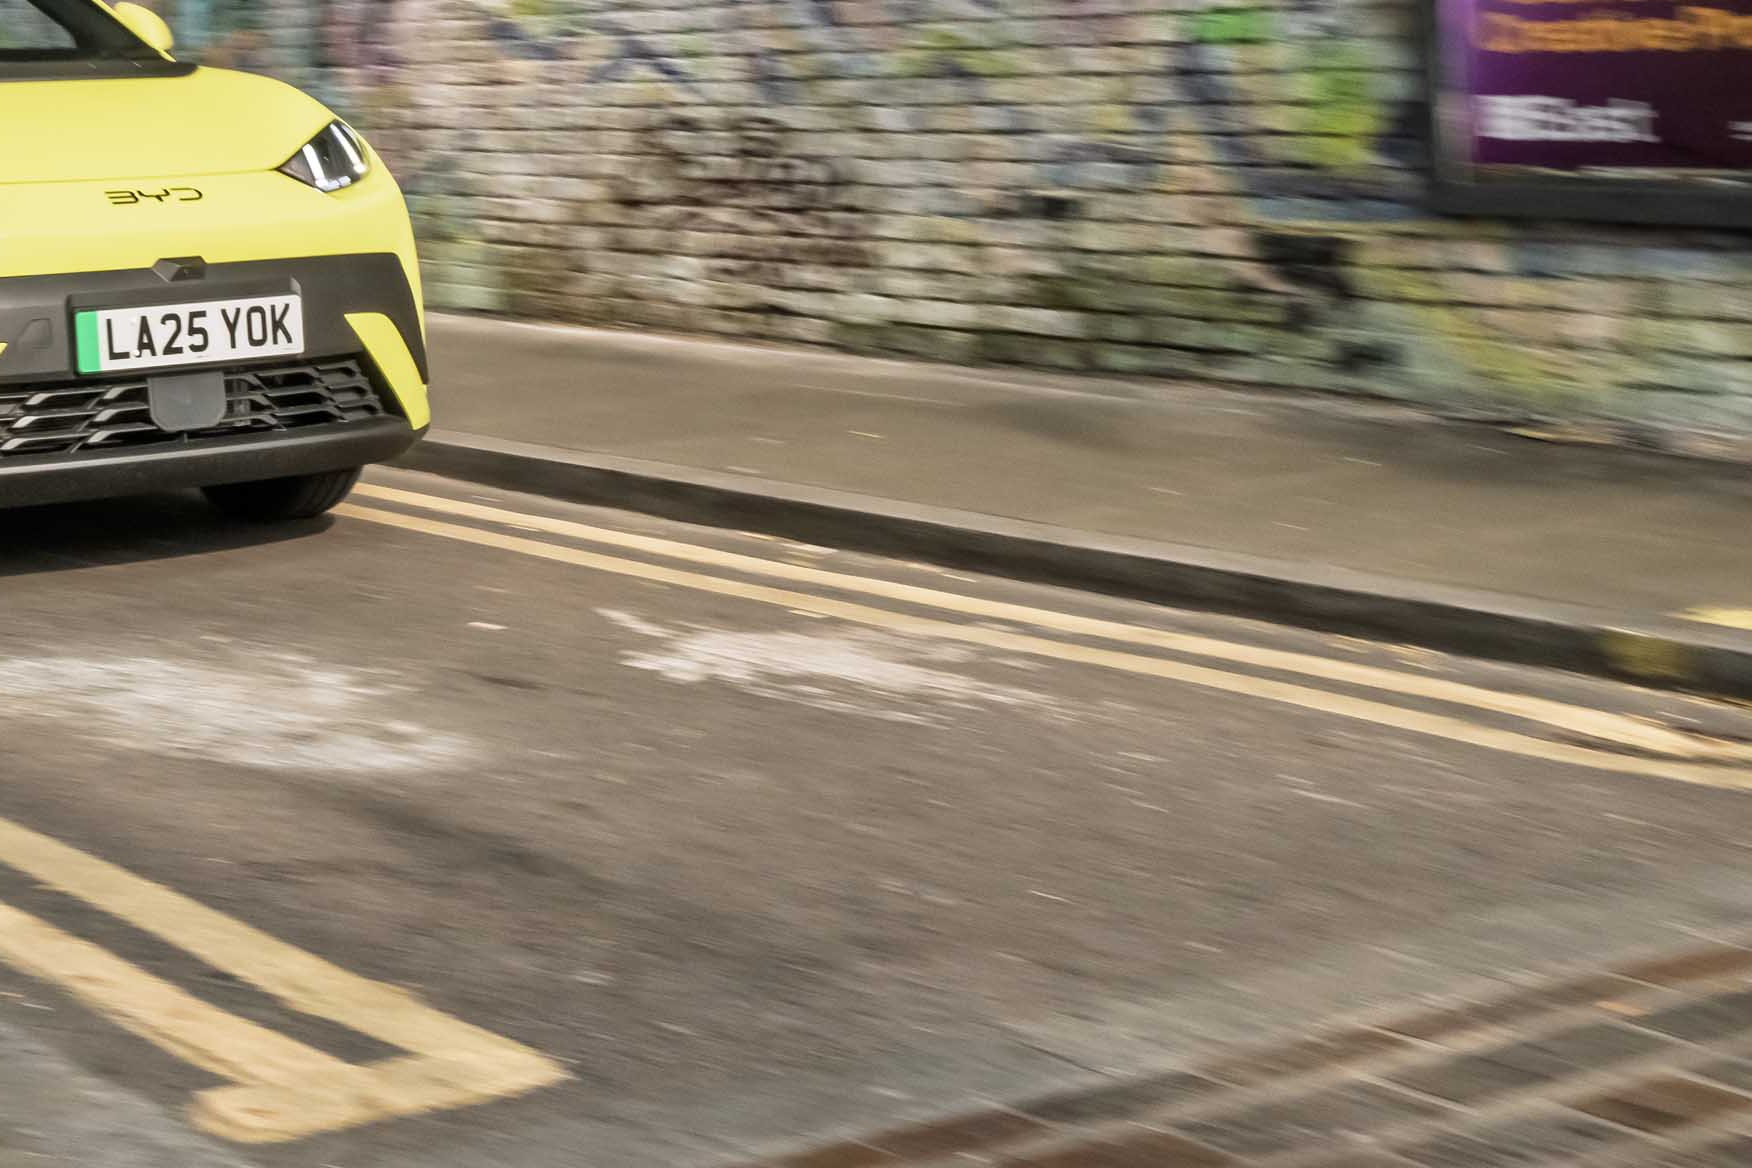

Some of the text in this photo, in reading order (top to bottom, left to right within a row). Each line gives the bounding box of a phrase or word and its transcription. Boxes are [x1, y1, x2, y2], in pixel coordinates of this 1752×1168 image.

[104, 187, 203, 205] BYD
[105, 303, 294, 361] LA25 YOK
